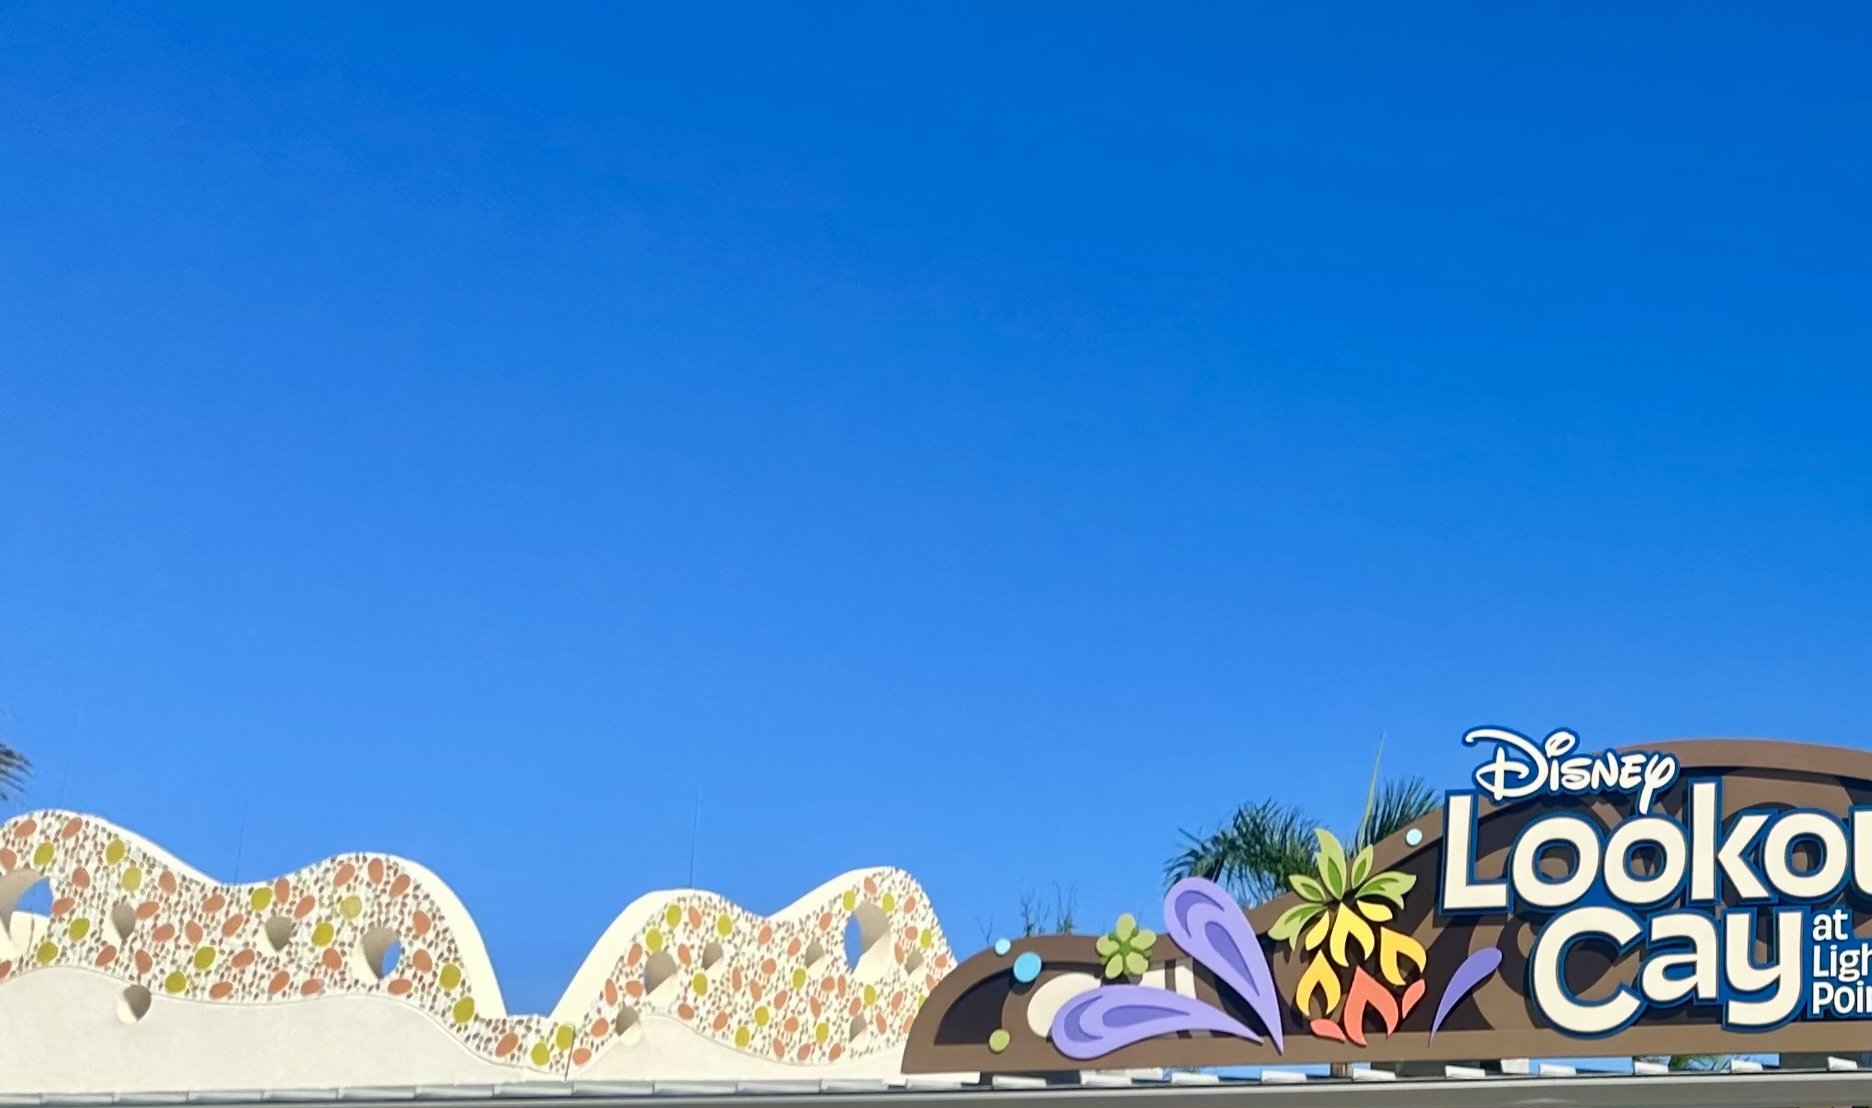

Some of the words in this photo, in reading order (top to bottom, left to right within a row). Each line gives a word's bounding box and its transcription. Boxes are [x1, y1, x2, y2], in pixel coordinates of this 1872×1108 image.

[1464, 726, 1676, 814] Disney
[1533, 905, 1802, 1033] Cay
[1812, 911, 1848, 941] at
